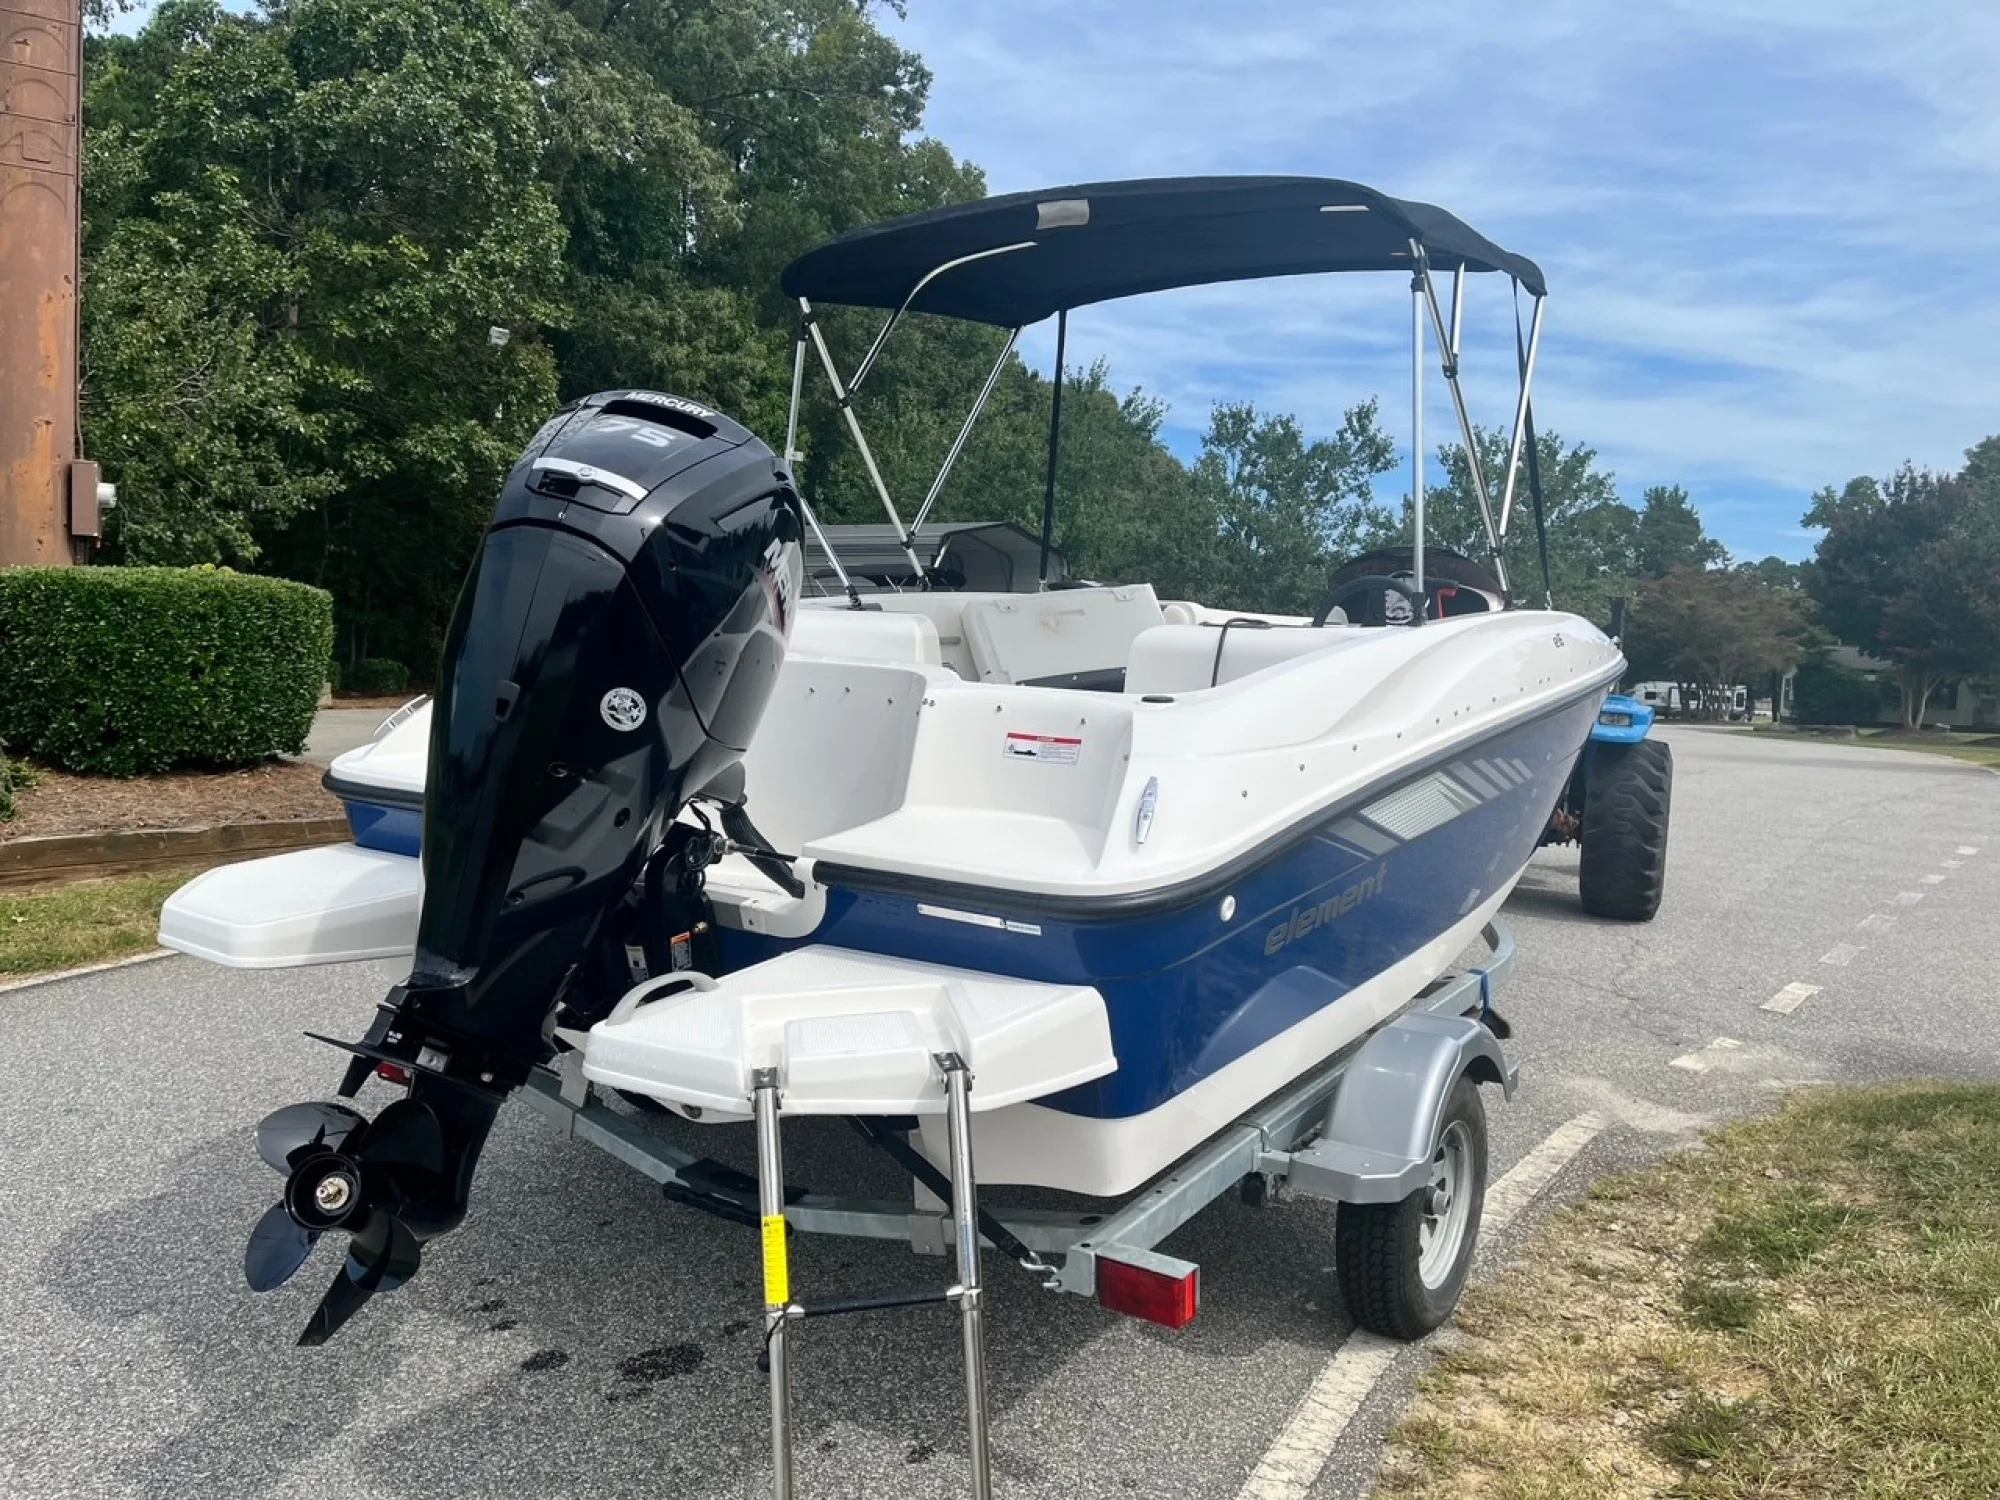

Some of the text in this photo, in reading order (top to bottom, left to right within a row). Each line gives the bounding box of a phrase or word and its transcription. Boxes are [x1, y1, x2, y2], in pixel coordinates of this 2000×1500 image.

[624, 391, 716, 417] MERCURY
[598, 420, 676, 448] 75
[1265, 863, 1387, 955] element
